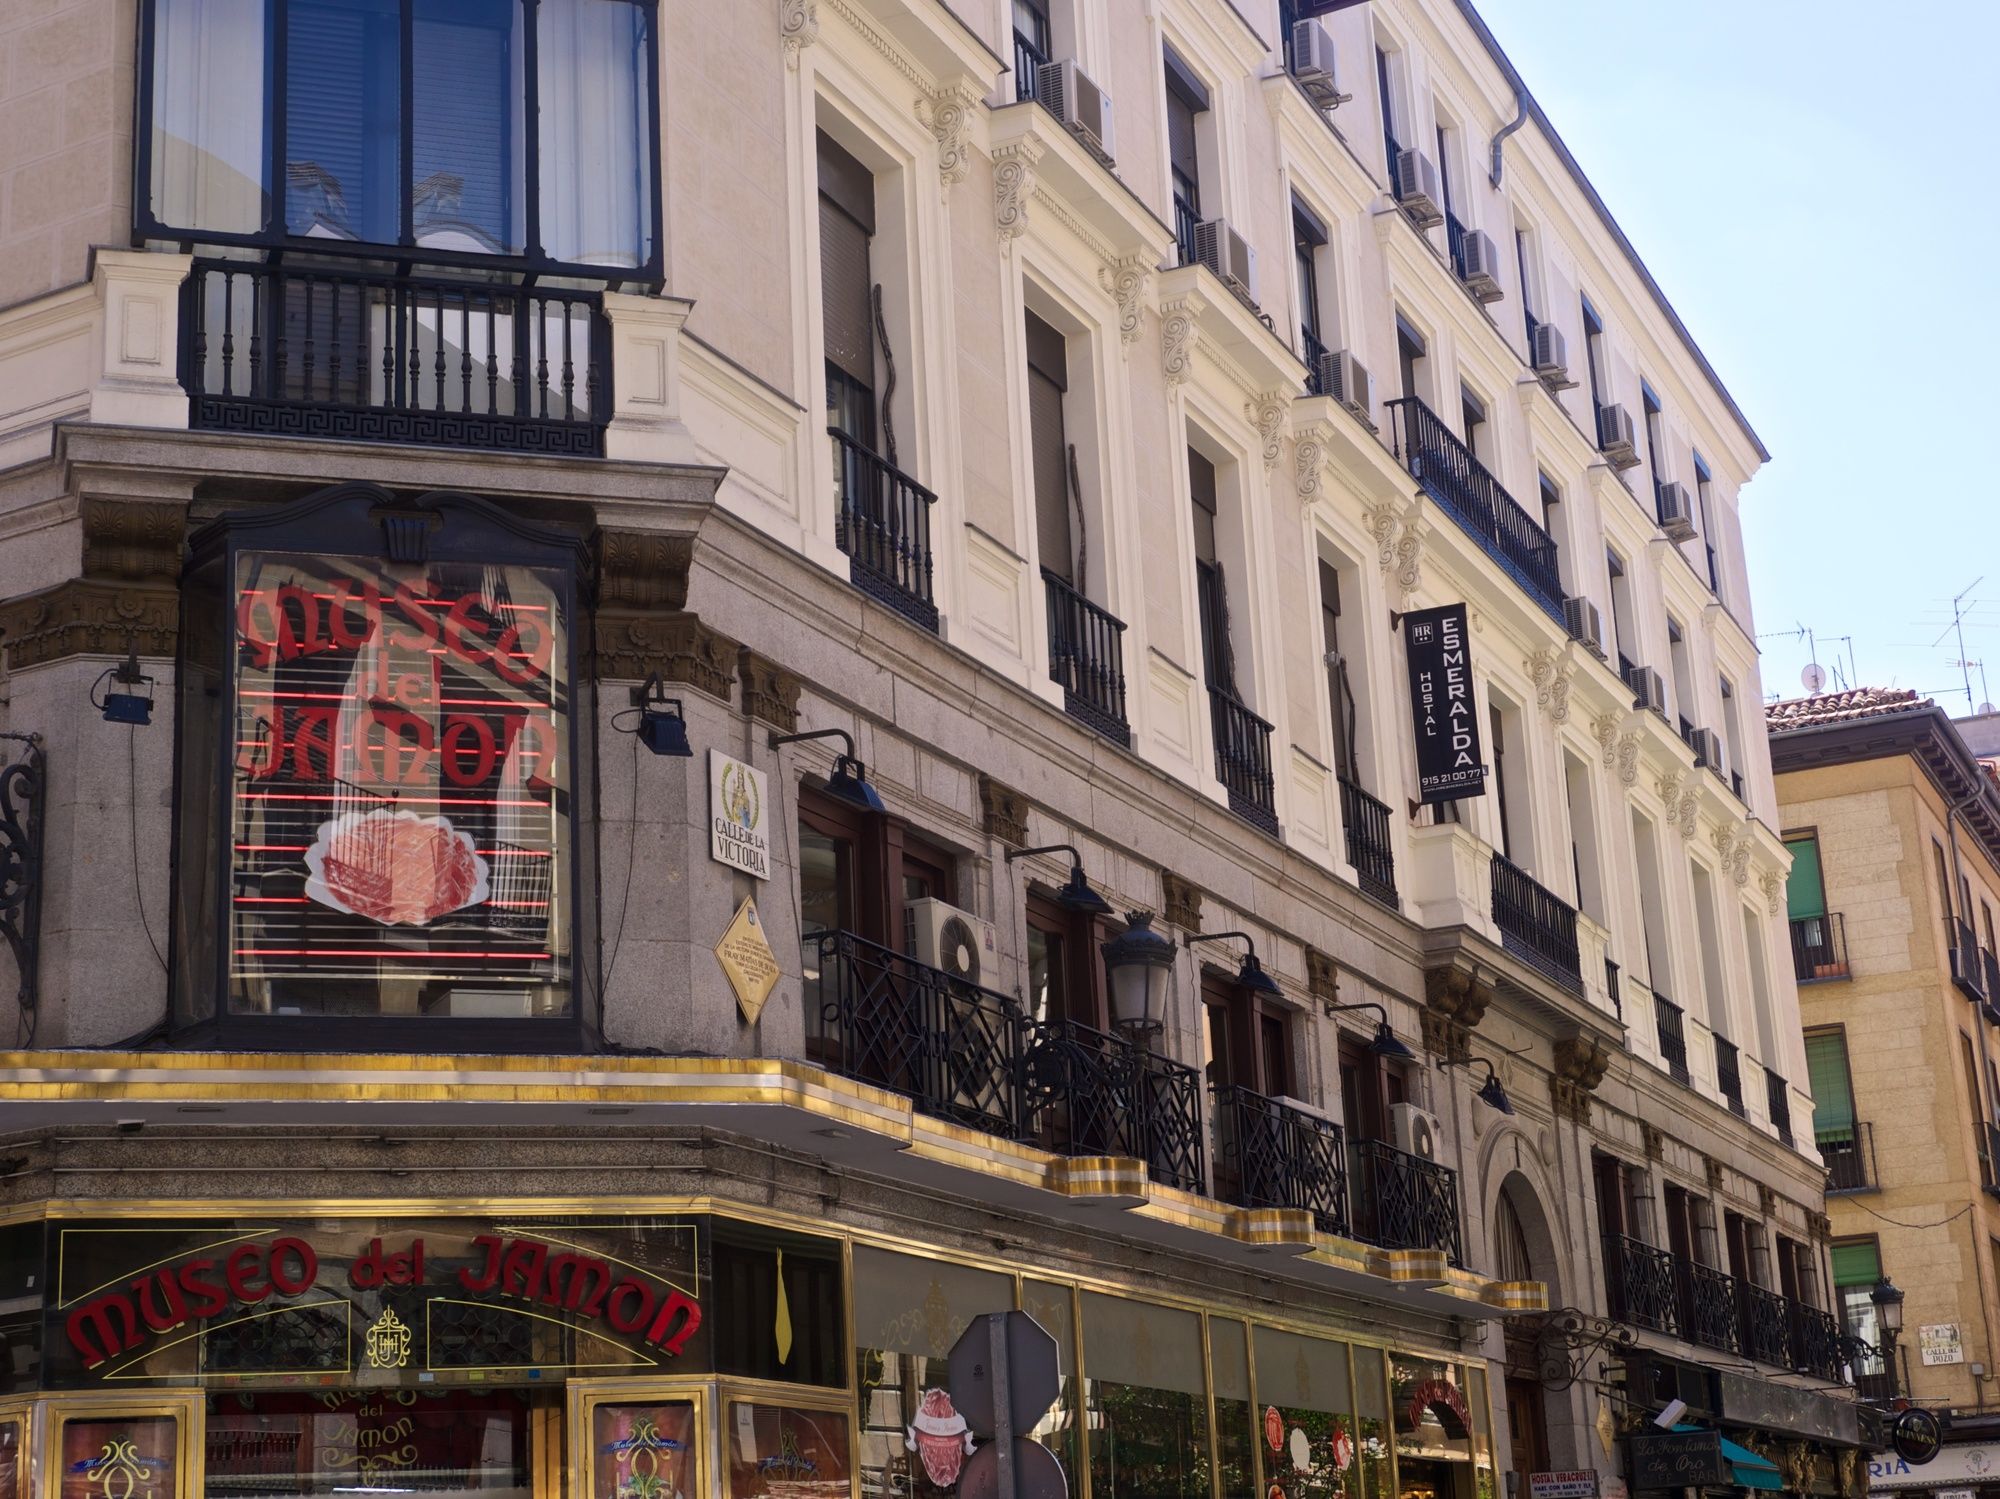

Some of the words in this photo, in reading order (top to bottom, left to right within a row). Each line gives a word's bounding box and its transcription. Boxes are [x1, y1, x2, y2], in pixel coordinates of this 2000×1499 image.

[237, 577, 554, 684] MUSEO
[1414, 622, 1431, 637] HR
[356, 651, 441, 704] del
[1442, 617, 1473, 767] ESMERALDA
[1420, 672, 1437, 736] HOSTAL
[237, 703, 557, 789] JAMON
[1422, 775, 1439, 786] 915
[1441, 774, 1451, 783] 21
[1467, 769, 1481, 778] 77
[715, 817, 745, 843] CALLE
[745, 831, 754, 845] DE
[755, 835, 765, 850] LA
[717, 836, 766, 874] VICTORIA
[65, 1237, 318, 1369] MUSEO
[351, 1237, 424, 1289] del
[458, 1235, 702, 1357] JAMON
[1932, 1354, 1953, 1363] POZO
[323, 1417, 415, 1448] JAMON
[1531, 1473, 1554, 1484] HOSTAL
[1675, 1454, 1704, 1472] Oro
[1689, 1470, 1716, 1482] BAR
